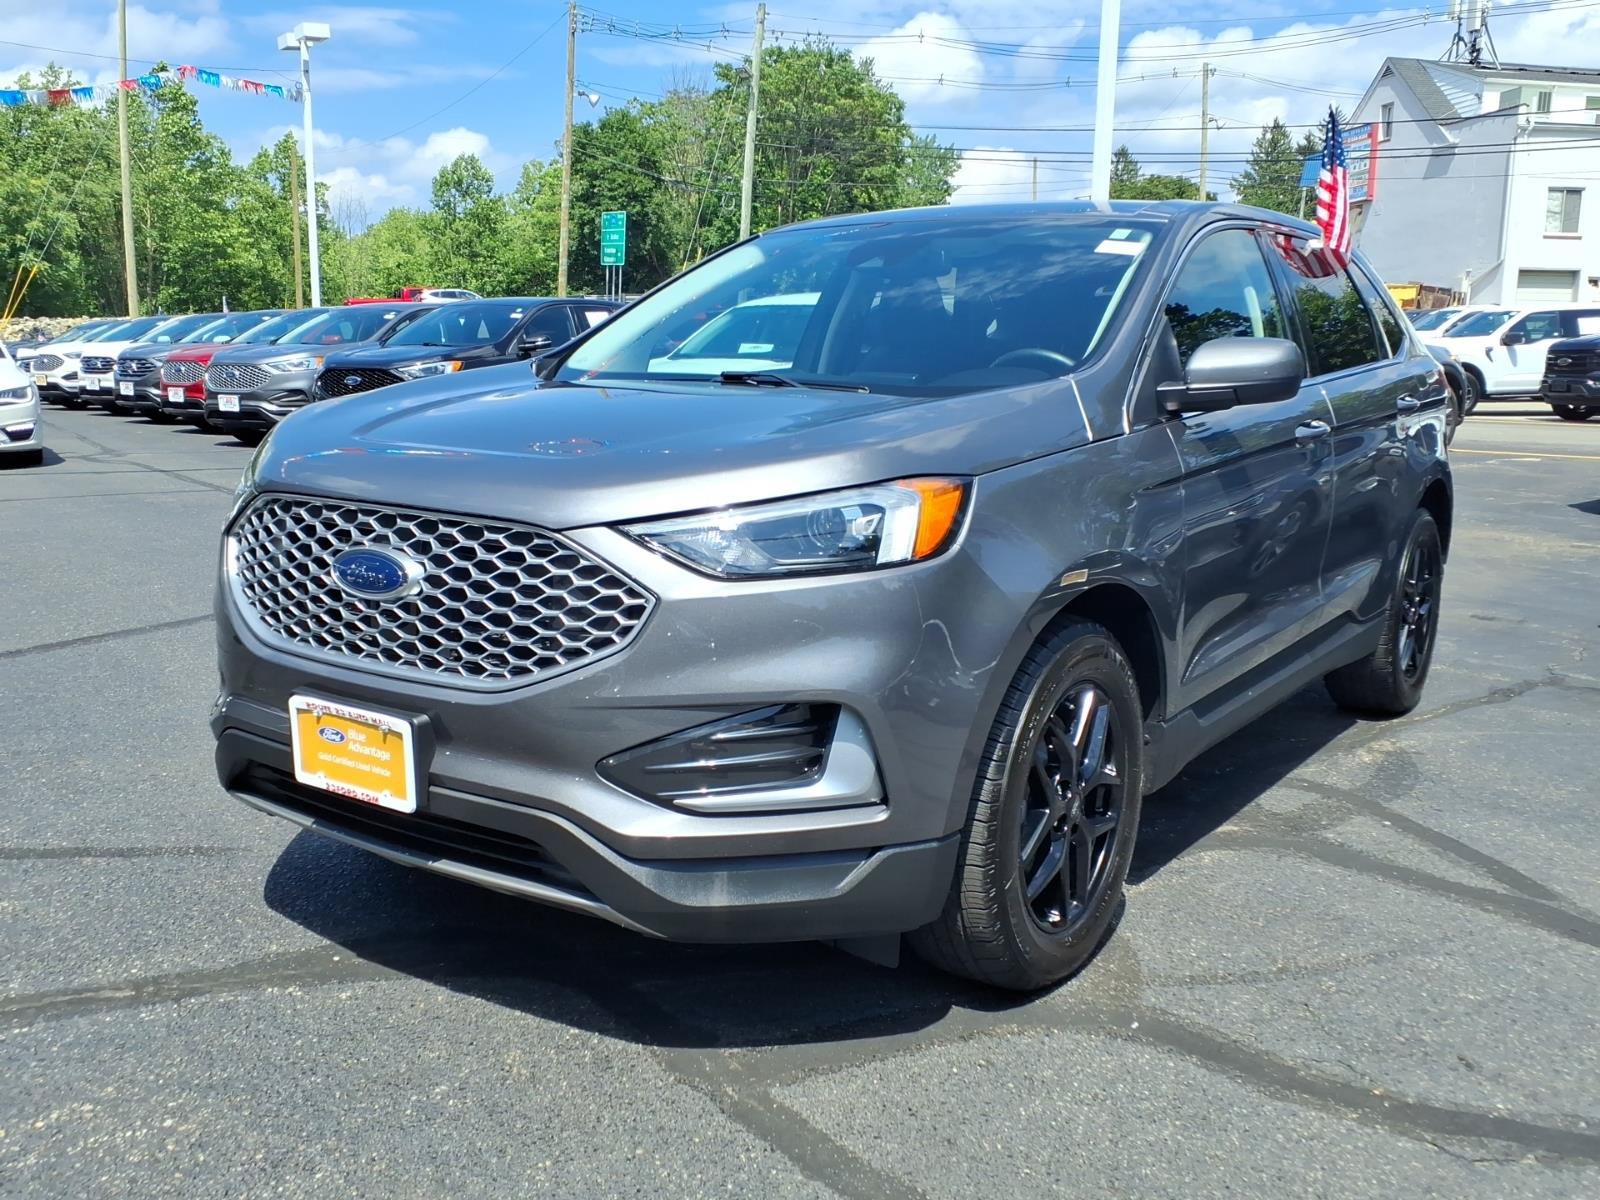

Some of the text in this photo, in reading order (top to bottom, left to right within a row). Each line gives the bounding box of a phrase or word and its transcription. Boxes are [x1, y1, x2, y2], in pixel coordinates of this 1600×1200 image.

[322, 727, 342, 742] Ford
[347, 728, 367, 742] Blue
[347, 741, 391, 761] Advantage
